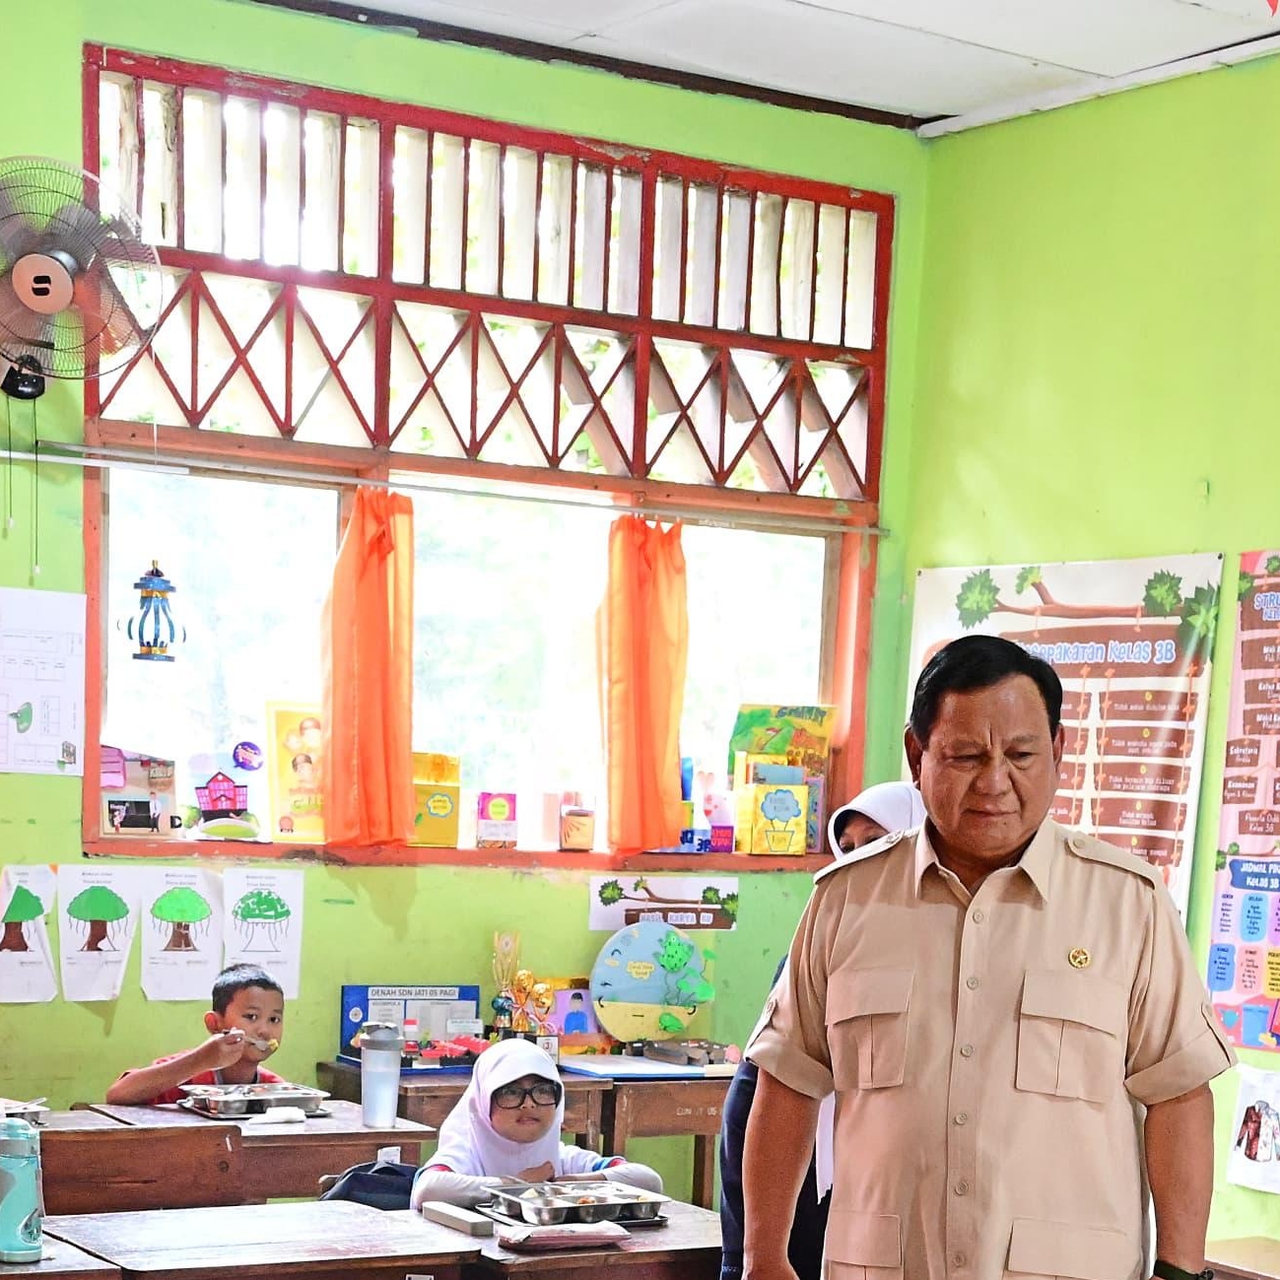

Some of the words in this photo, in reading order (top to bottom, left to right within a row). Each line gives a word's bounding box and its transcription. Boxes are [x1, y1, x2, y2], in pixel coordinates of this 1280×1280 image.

[1154, 640, 1175, 663] 3B
[1241, 862, 1267, 874] JADWAL
[372, 989, 396, 997] DENAH
[398, 989, 413, 997] SDN
[414, 989, 428, 997] JATI
[439, 989, 456, 997] PAGI
